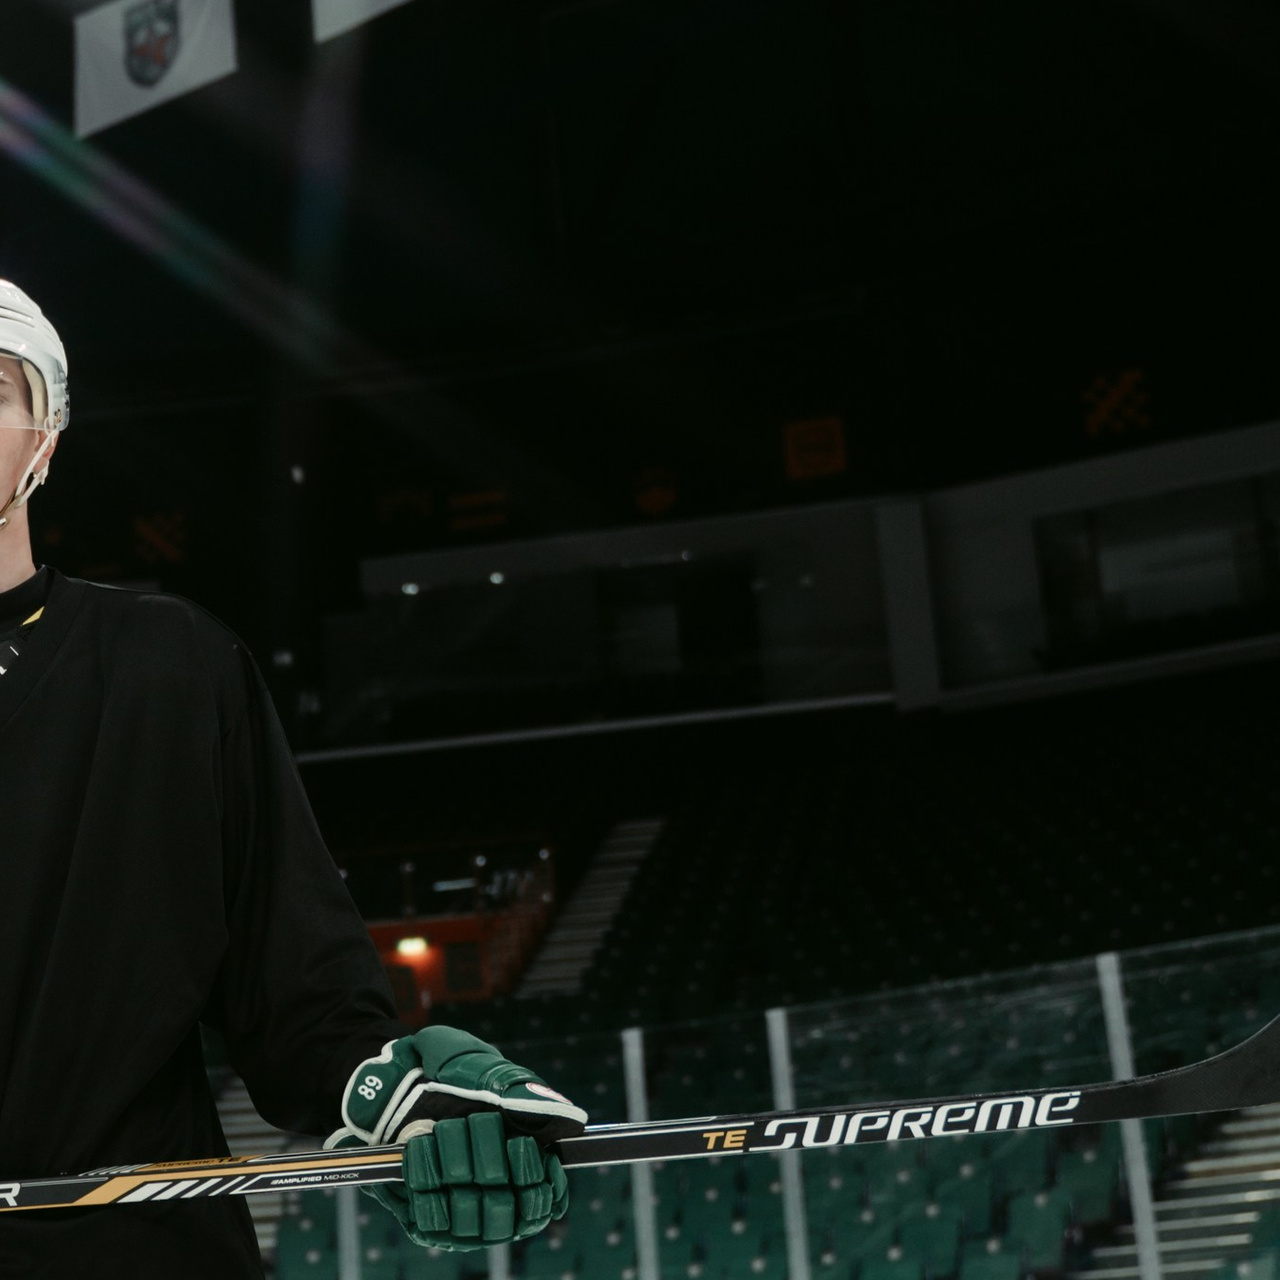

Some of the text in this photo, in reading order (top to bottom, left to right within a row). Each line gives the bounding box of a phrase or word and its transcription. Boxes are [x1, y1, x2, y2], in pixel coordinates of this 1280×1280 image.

[357, 1075, 383, 1101] 89
[702, 1091, 1081, 1151] TE SUPREME
[277, 1172, 360, 1185] AMPLIFIED MID-KICK
